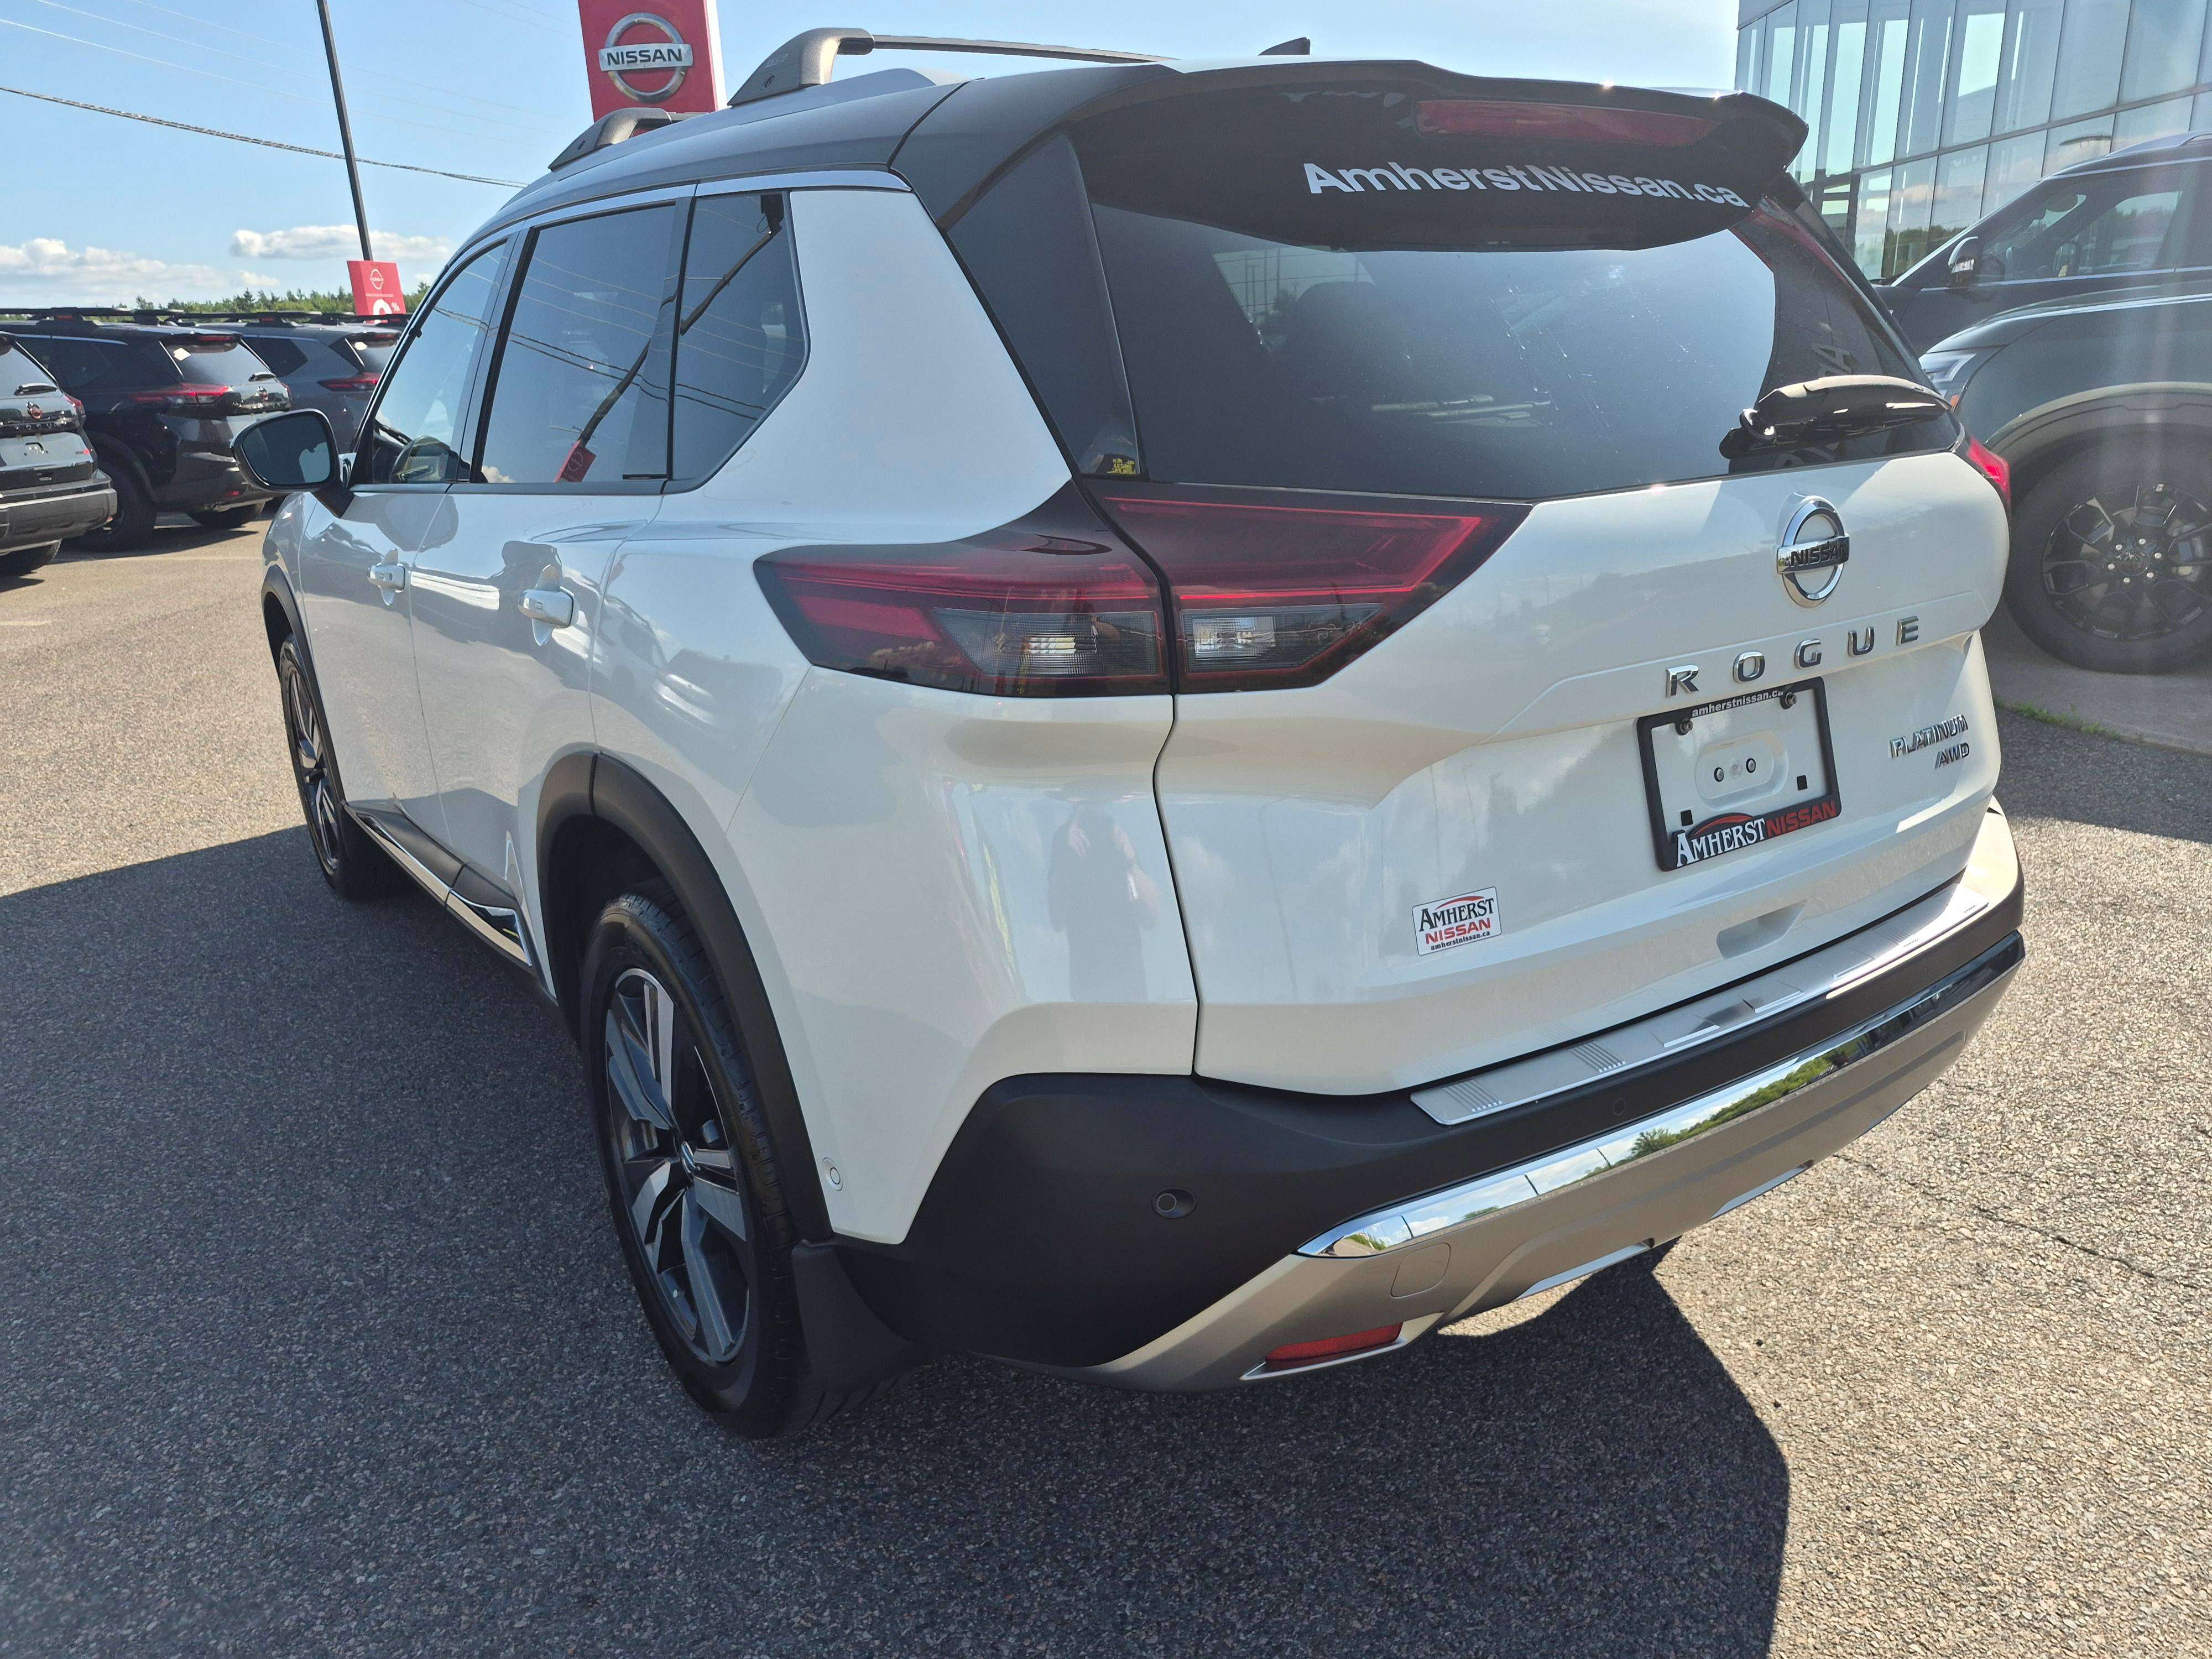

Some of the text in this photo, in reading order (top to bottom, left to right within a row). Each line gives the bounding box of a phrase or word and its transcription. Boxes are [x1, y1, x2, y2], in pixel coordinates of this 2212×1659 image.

[607, 48, 683, 66] NISSAN
[1303, 161, 1750, 208] AmherstNissan.ca
[1791, 539, 1849, 567] NISSAN
[1666, 616, 1919, 697] ROGUE
[1692, 691, 1784, 717] amherstnissan.ca
[1890, 714, 1969, 759] PLATINUM
[1934, 742, 1970, 770] AWD
[1676, 800, 1837, 867] AMHERST NISSAN
[1419, 898, 1495, 932] AMHERST
[1425, 917, 1491, 945] NISSAN
[1430, 930, 1491, 951] amherstnissan.ca
